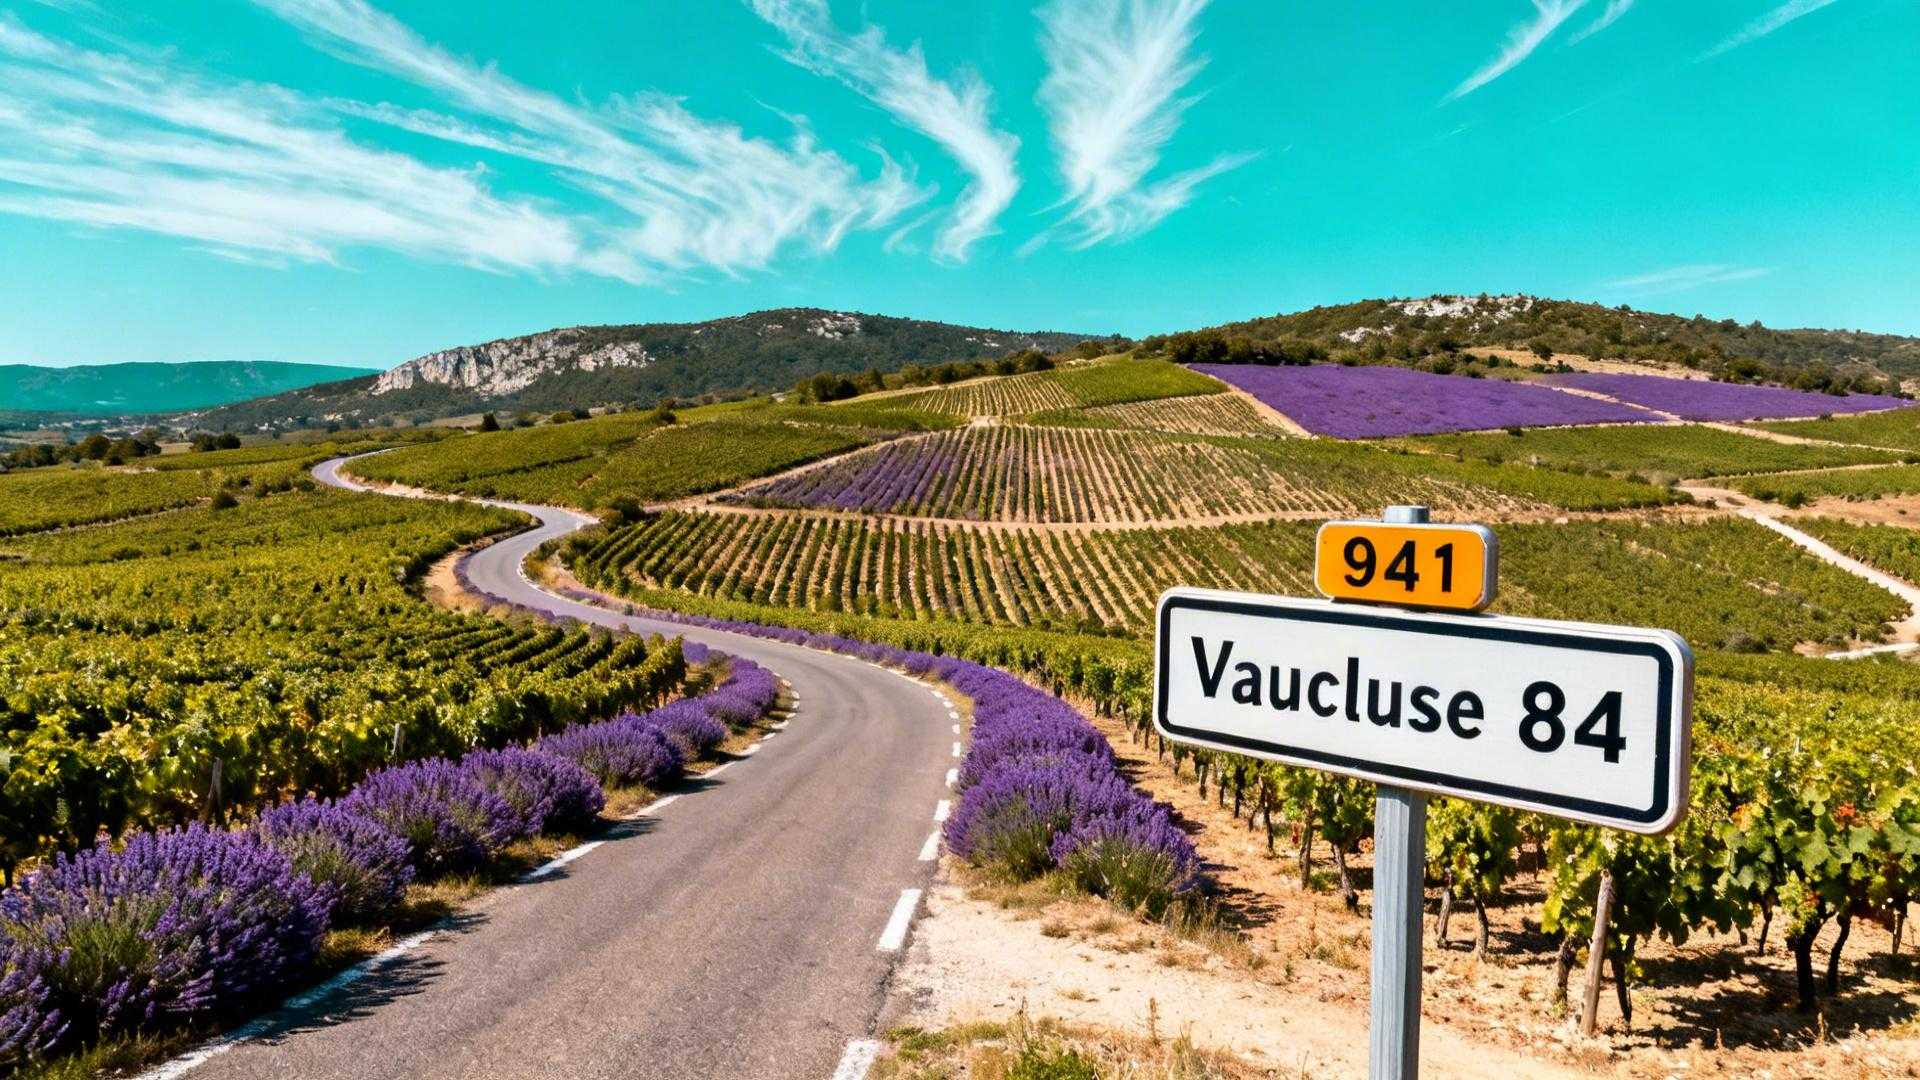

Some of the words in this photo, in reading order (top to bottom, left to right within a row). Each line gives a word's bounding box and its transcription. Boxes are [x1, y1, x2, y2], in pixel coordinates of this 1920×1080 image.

[1343, 536, 1453, 593] 941
[1191, 636, 1485, 740] Vaucluse
[1518, 681, 1627, 764] 84
